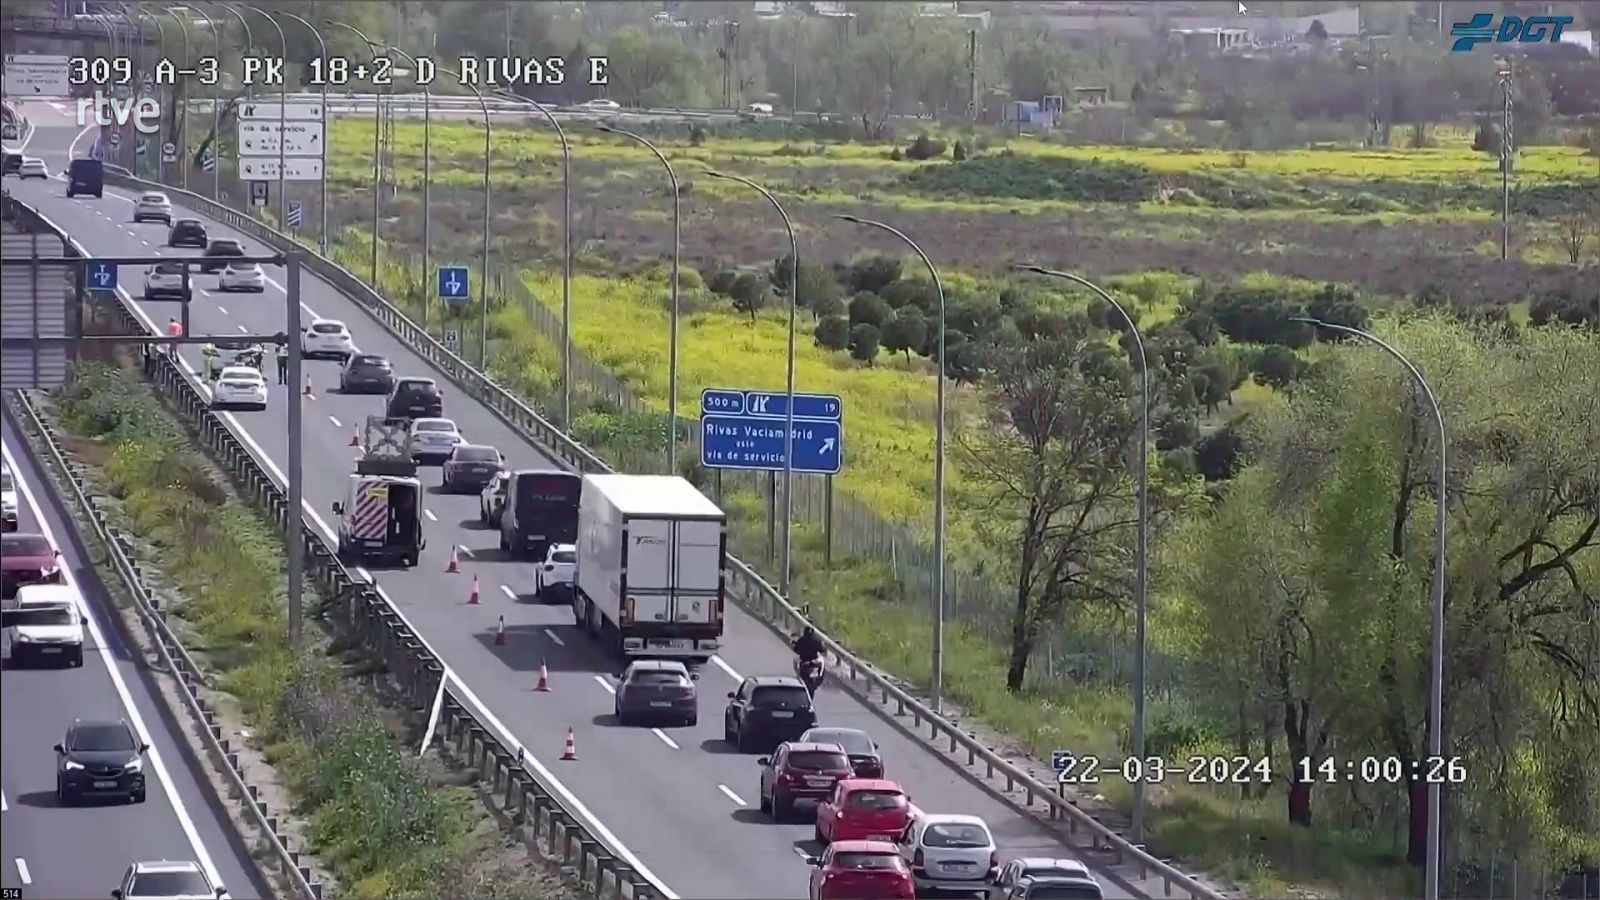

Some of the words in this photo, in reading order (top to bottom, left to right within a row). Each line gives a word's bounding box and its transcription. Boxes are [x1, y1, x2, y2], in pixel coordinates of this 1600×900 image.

[707, 397, 728, 407] 500
[731, 399, 739, 408] m
[824, 403, 836, 413] 19
[706, 423, 738, 436] Rivas
[744, 426, 813, 440] Vaciamdrid
[727, 451, 738, 461] de
[744, 451, 785, 463] servicio
